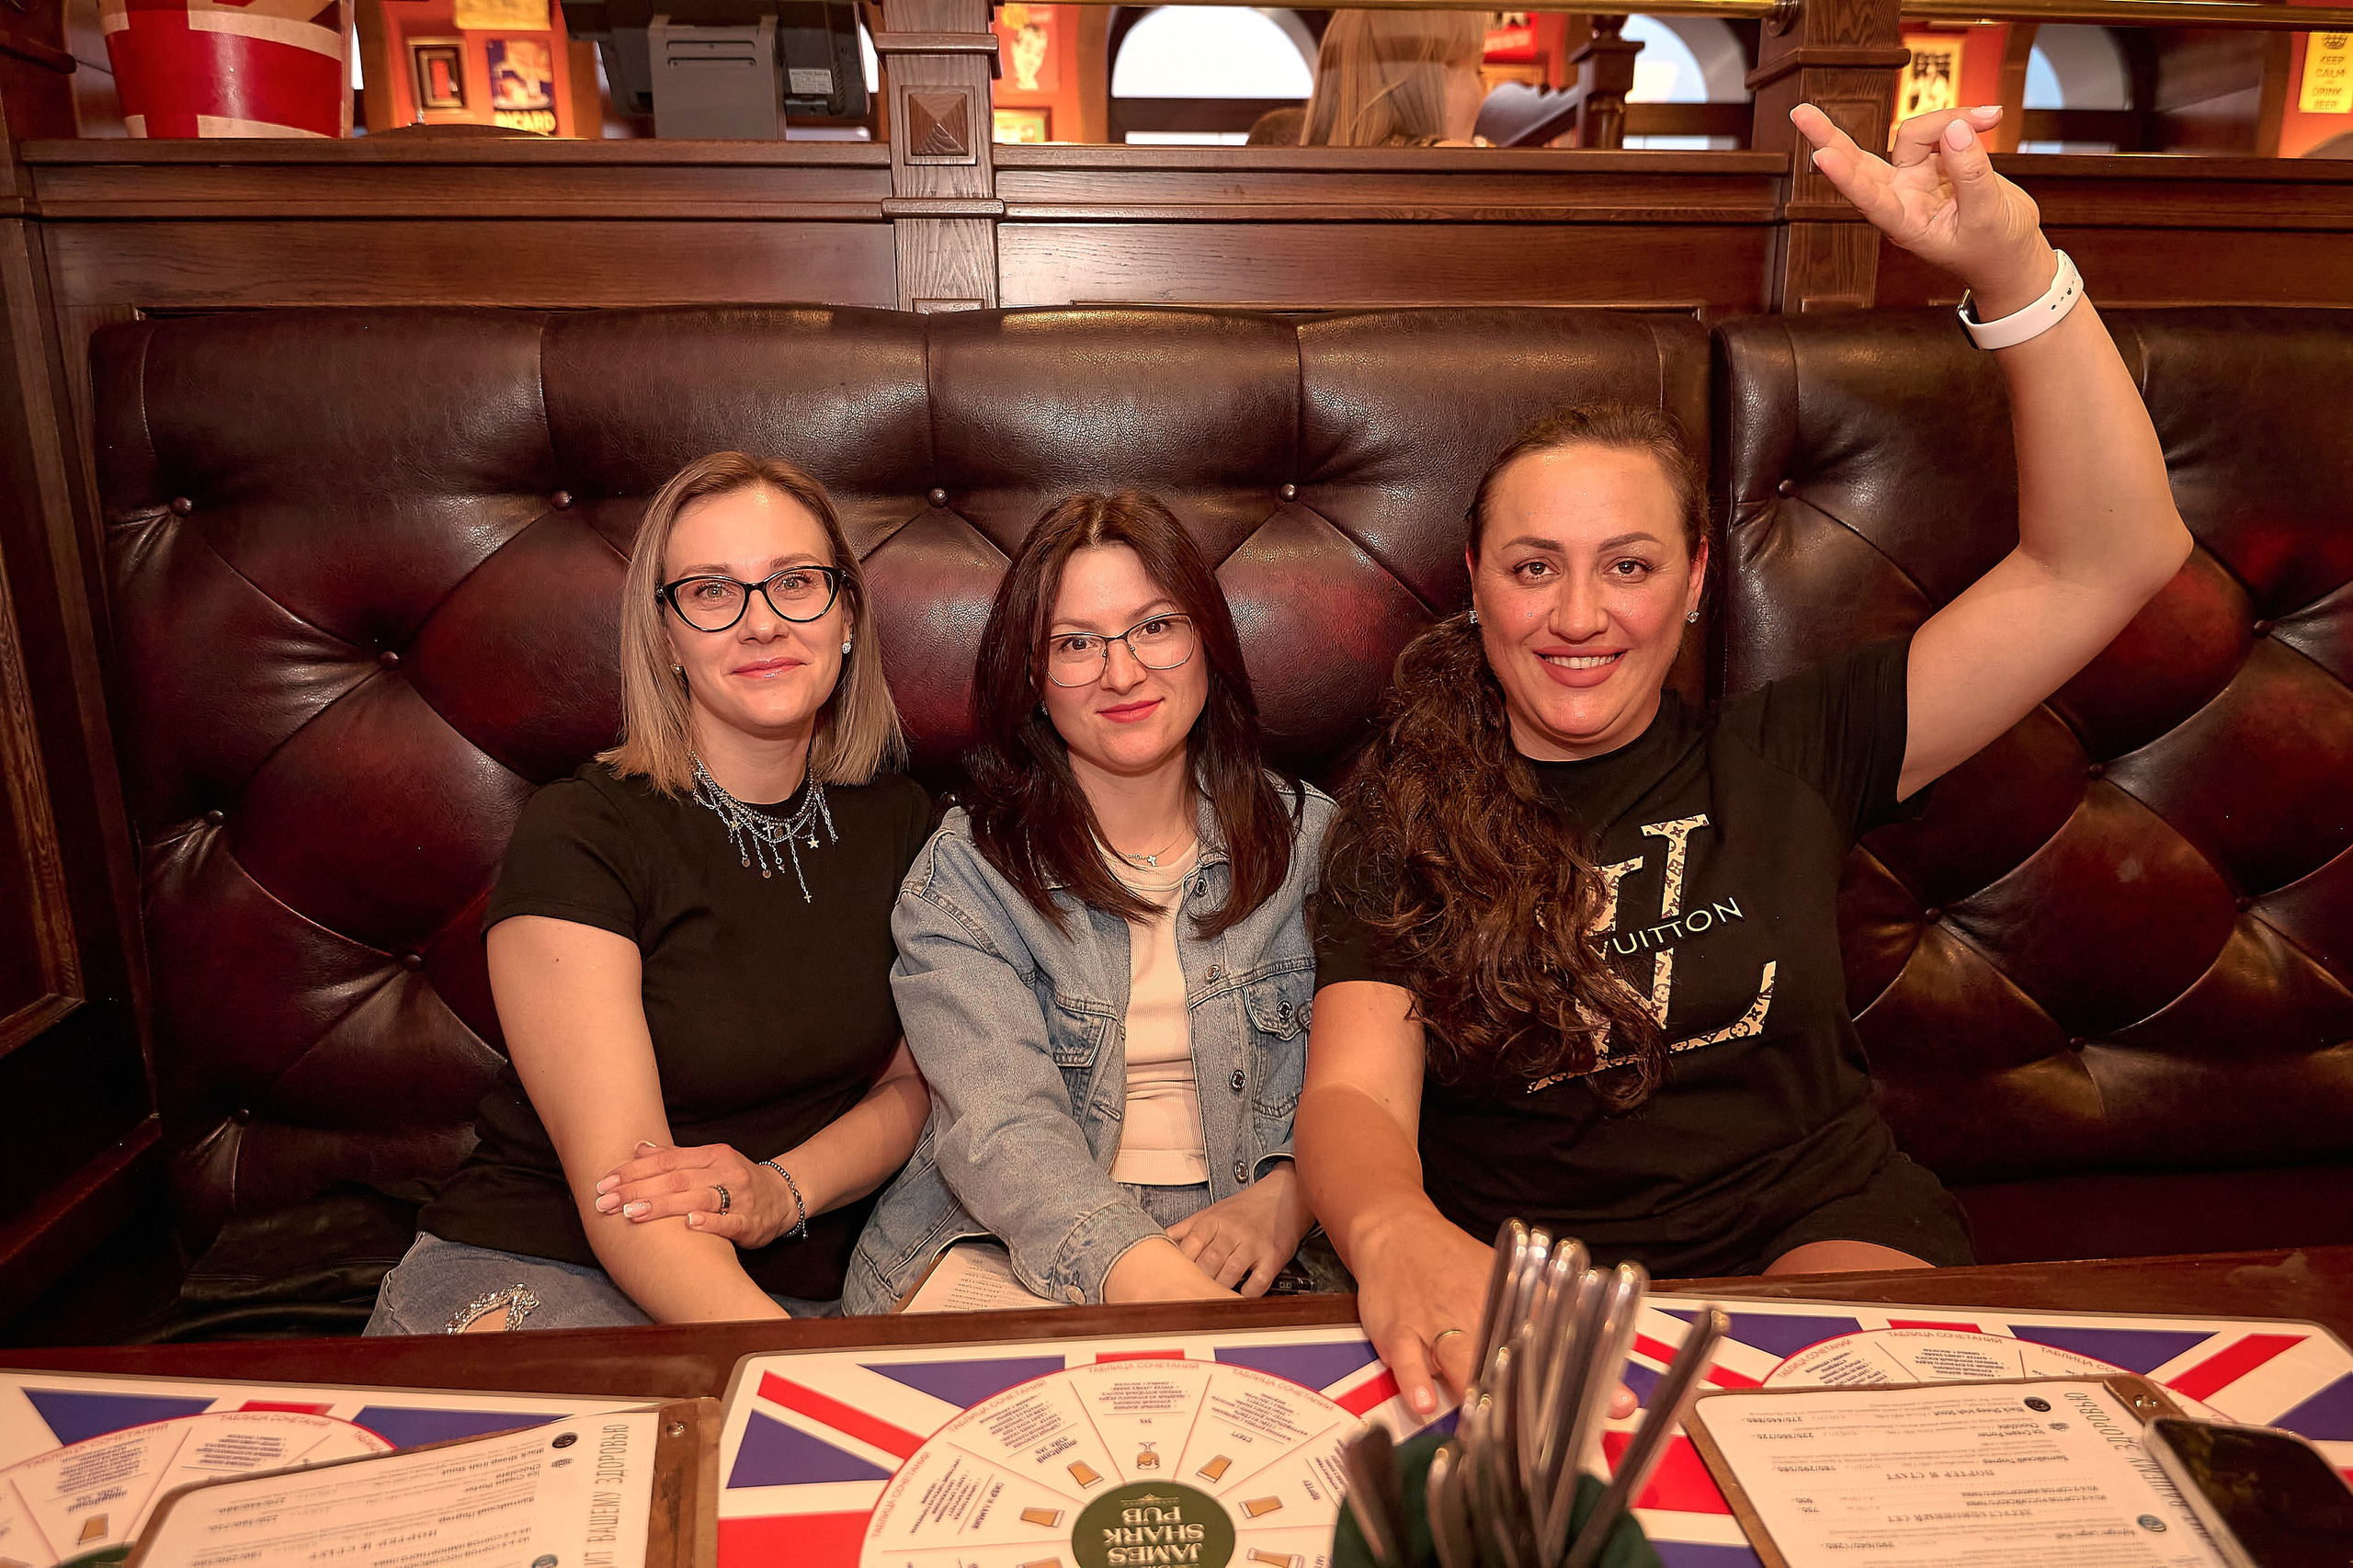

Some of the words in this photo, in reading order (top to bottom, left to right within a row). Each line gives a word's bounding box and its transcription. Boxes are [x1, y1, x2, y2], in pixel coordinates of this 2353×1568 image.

[2320, 55, 2345, 65] KEEP
[2315, 69, 2345, 78] CALM
[2312, 87, 2342, 97] DRINK
[2313, 100, 2338, 110] BEER
[1089, 1363, 1136, 1372] ТАБЛИЦА
[1232, 1369, 1276, 1388] ТАБЛИЦА
[1278, 1382, 1335, 1412] СОЧЕТАНИЙ
[947, 1404, 988, 1432] ТАБЛИЦА
[989, 1379, 1047, 1406] СОЧЕТАНИЙ
[2064, 1392, 2141, 1449] ЗДОРОВЬЮ
[595, 1424, 630, 1483] ЗДОРОВЬЮ
[586, 1491, 621, 1542] ВАШЕМУ
[871, 1497, 897, 1540] ТАБЛИЦА
[1120, 1506, 1182, 1526] PUB
[1101, 1523, 1205, 1546] SHARK
[1106, 1542, 1203, 1564] JAMES
